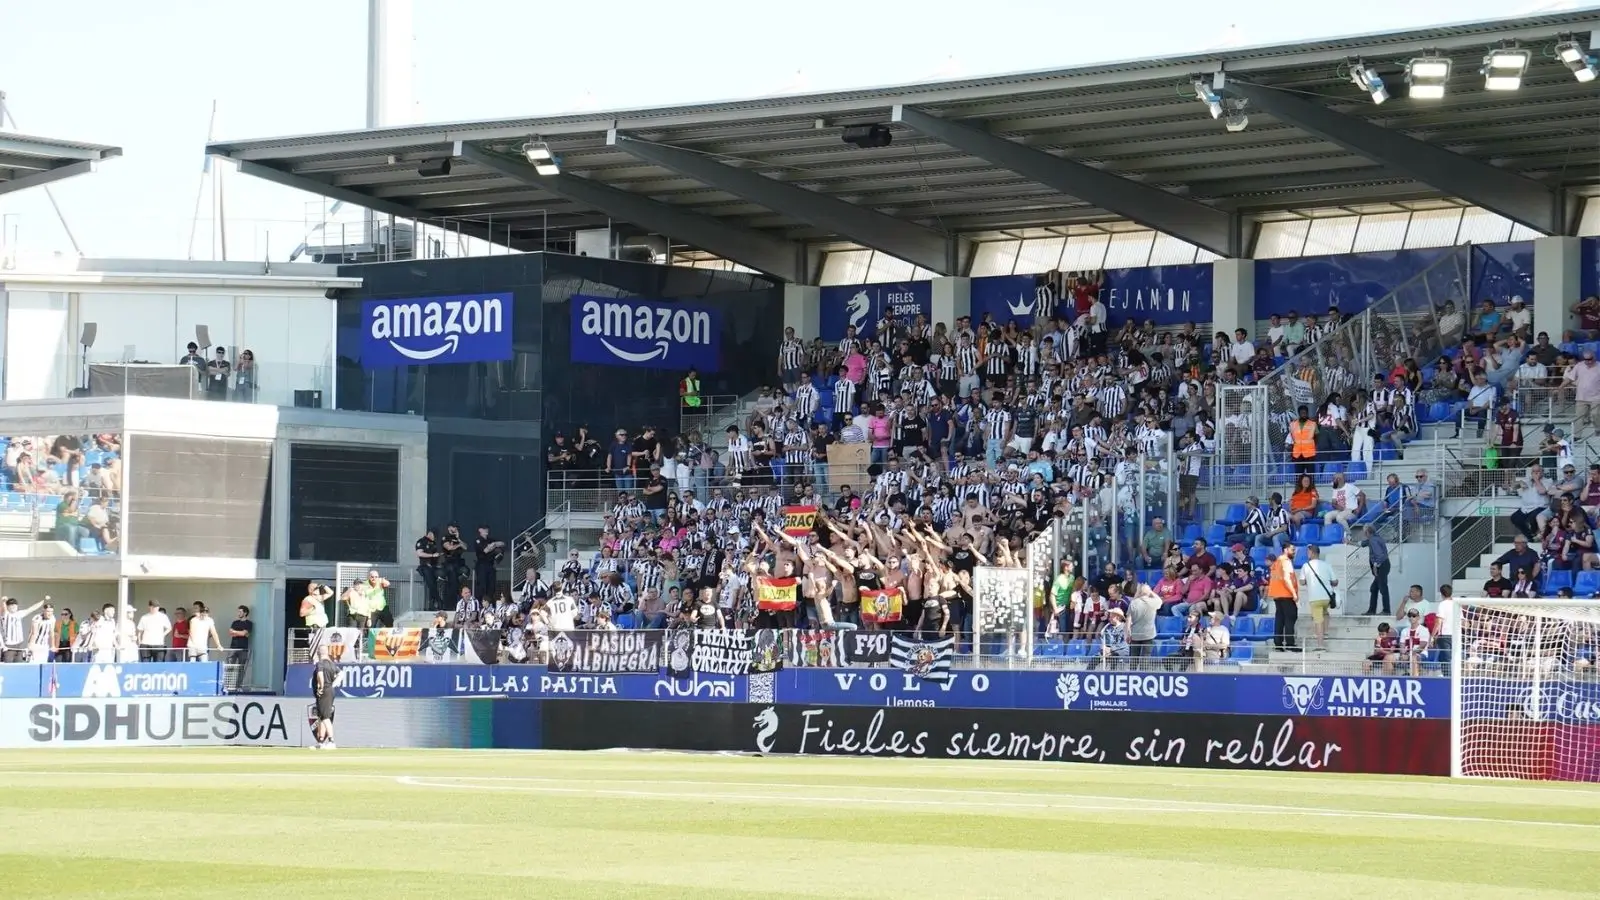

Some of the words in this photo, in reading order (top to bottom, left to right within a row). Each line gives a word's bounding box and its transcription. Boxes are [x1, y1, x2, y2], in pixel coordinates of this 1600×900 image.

[887, 292, 914, 303] FIELES
[371, 299, 502, 339] amazon
[581, 300, 710, 345] amazon
[572, 645, 658, 673] ALBINEGRA
[309, 664, 413, 689] mazon
[455, 674, 529, 692] LILLAS
[541, 675, 618, 694] PASTIA
[1083, 675, 1189, 698] QUERQUS
[1328, 678, 1426, 706] AMBAR
[28, 702, 288, 742] SDHUESCA
[800, 708, 929, 754] Fieles
[946, 722, 1107, 762] siempre,
[1125, 728, 1187, 765] sin
[1204, 718, 1342, 769] reblar
